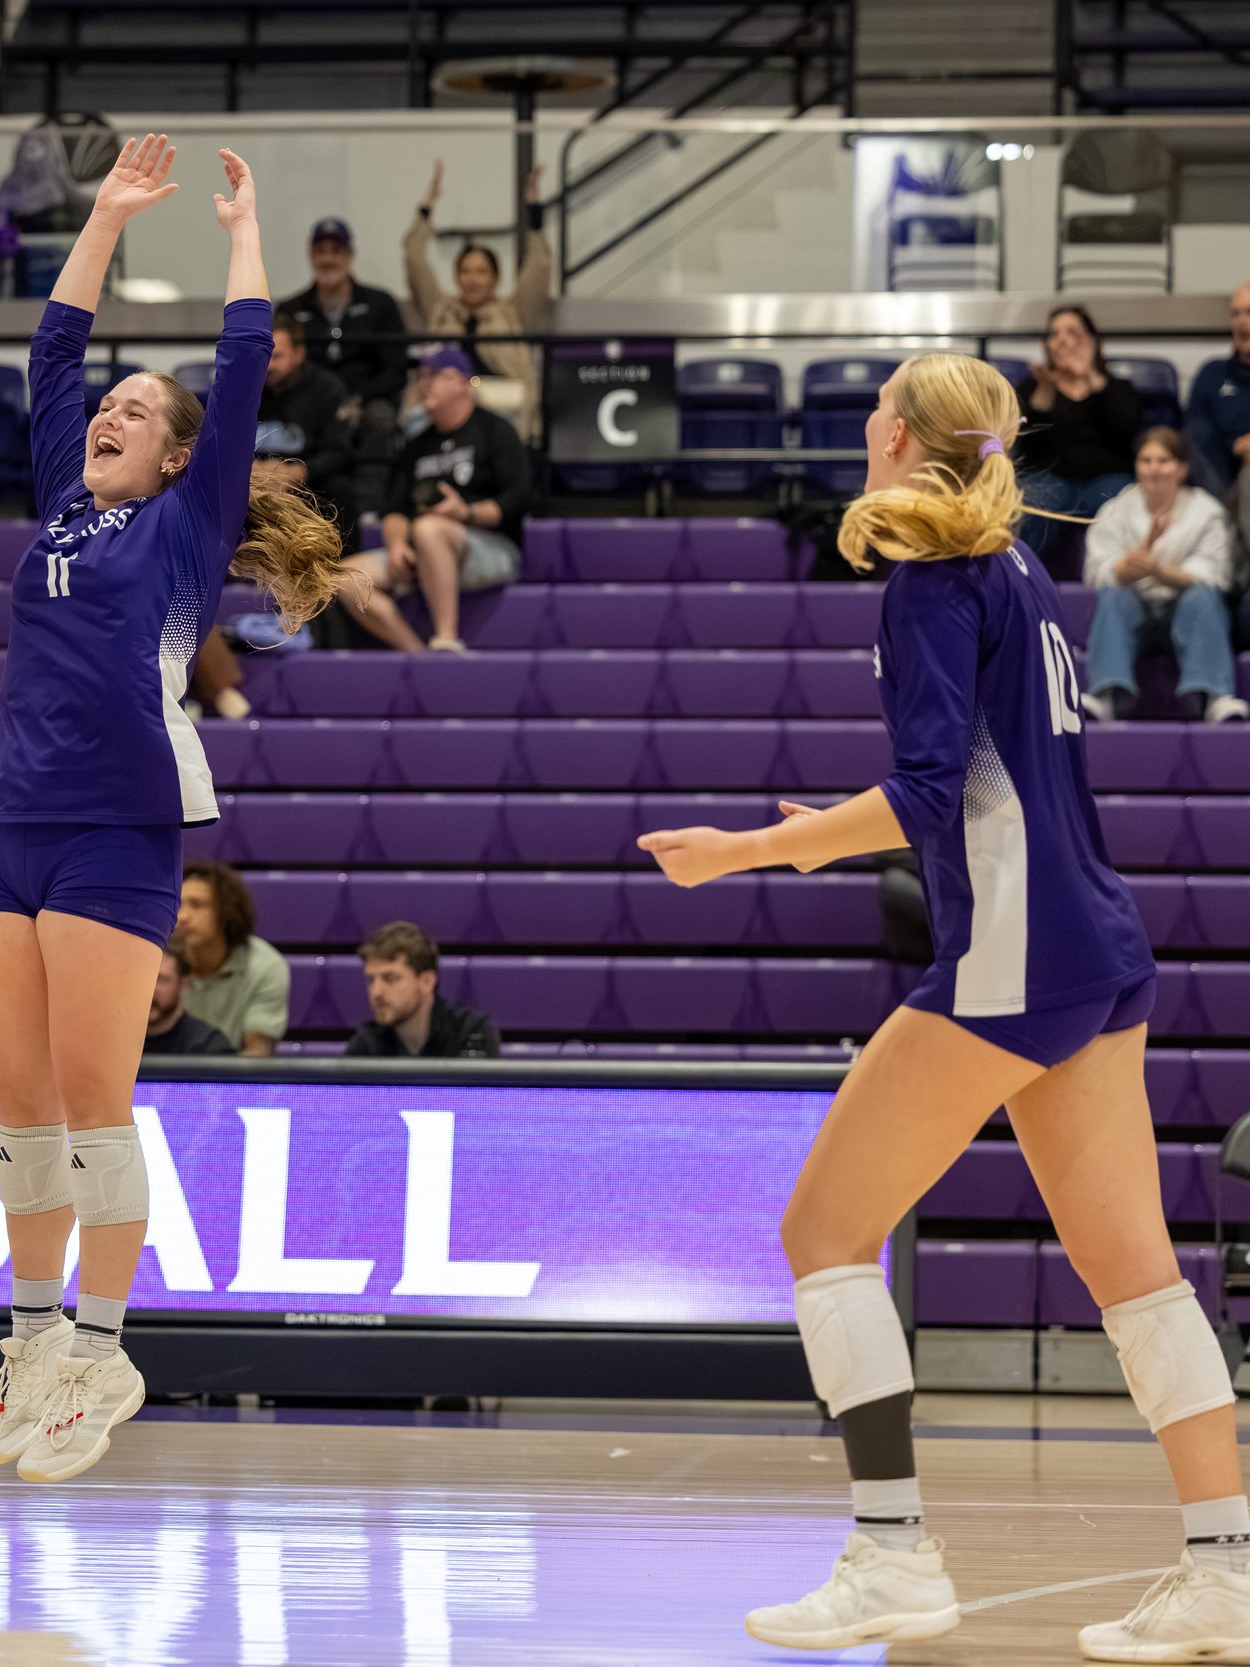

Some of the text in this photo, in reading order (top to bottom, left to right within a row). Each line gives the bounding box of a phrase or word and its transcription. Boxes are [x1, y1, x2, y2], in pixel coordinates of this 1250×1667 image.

[597, 388, 638, 447] C
[75, 508, 133, 538] OSS
[47, 551, 79, 598] 11
[1039, 618, 1082, 736] 10
